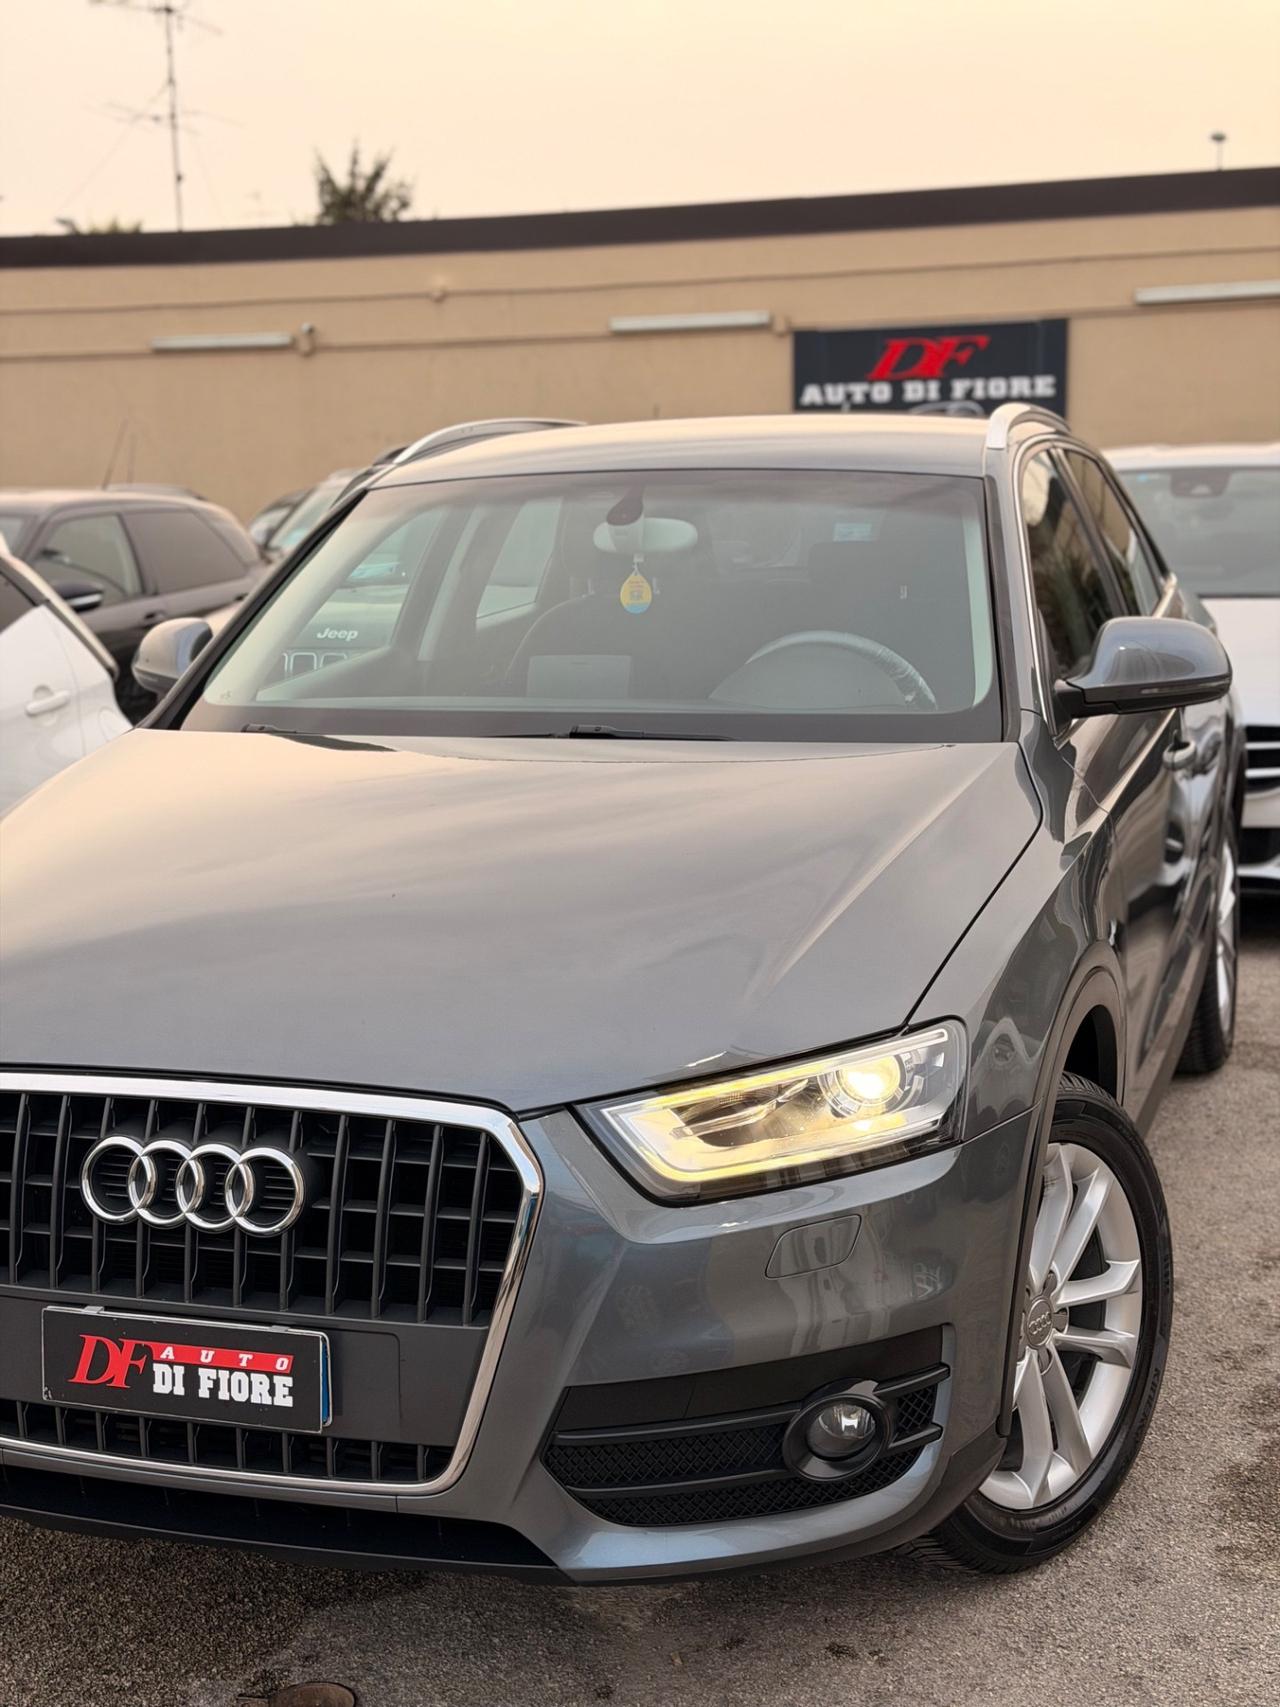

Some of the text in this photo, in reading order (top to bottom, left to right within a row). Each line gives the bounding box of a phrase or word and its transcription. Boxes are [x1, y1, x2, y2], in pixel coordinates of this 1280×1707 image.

[866, 334, 991, 380] DF
[800, 374, 1056, 406] AUTO DI FIORE
[317, 627, 359, 642] Jeep
[67, 1334, 150, 1389] DF
[160, 1346, 289, 1371] AUTO
[153, 1363, 294, 1407] DI FIORE
